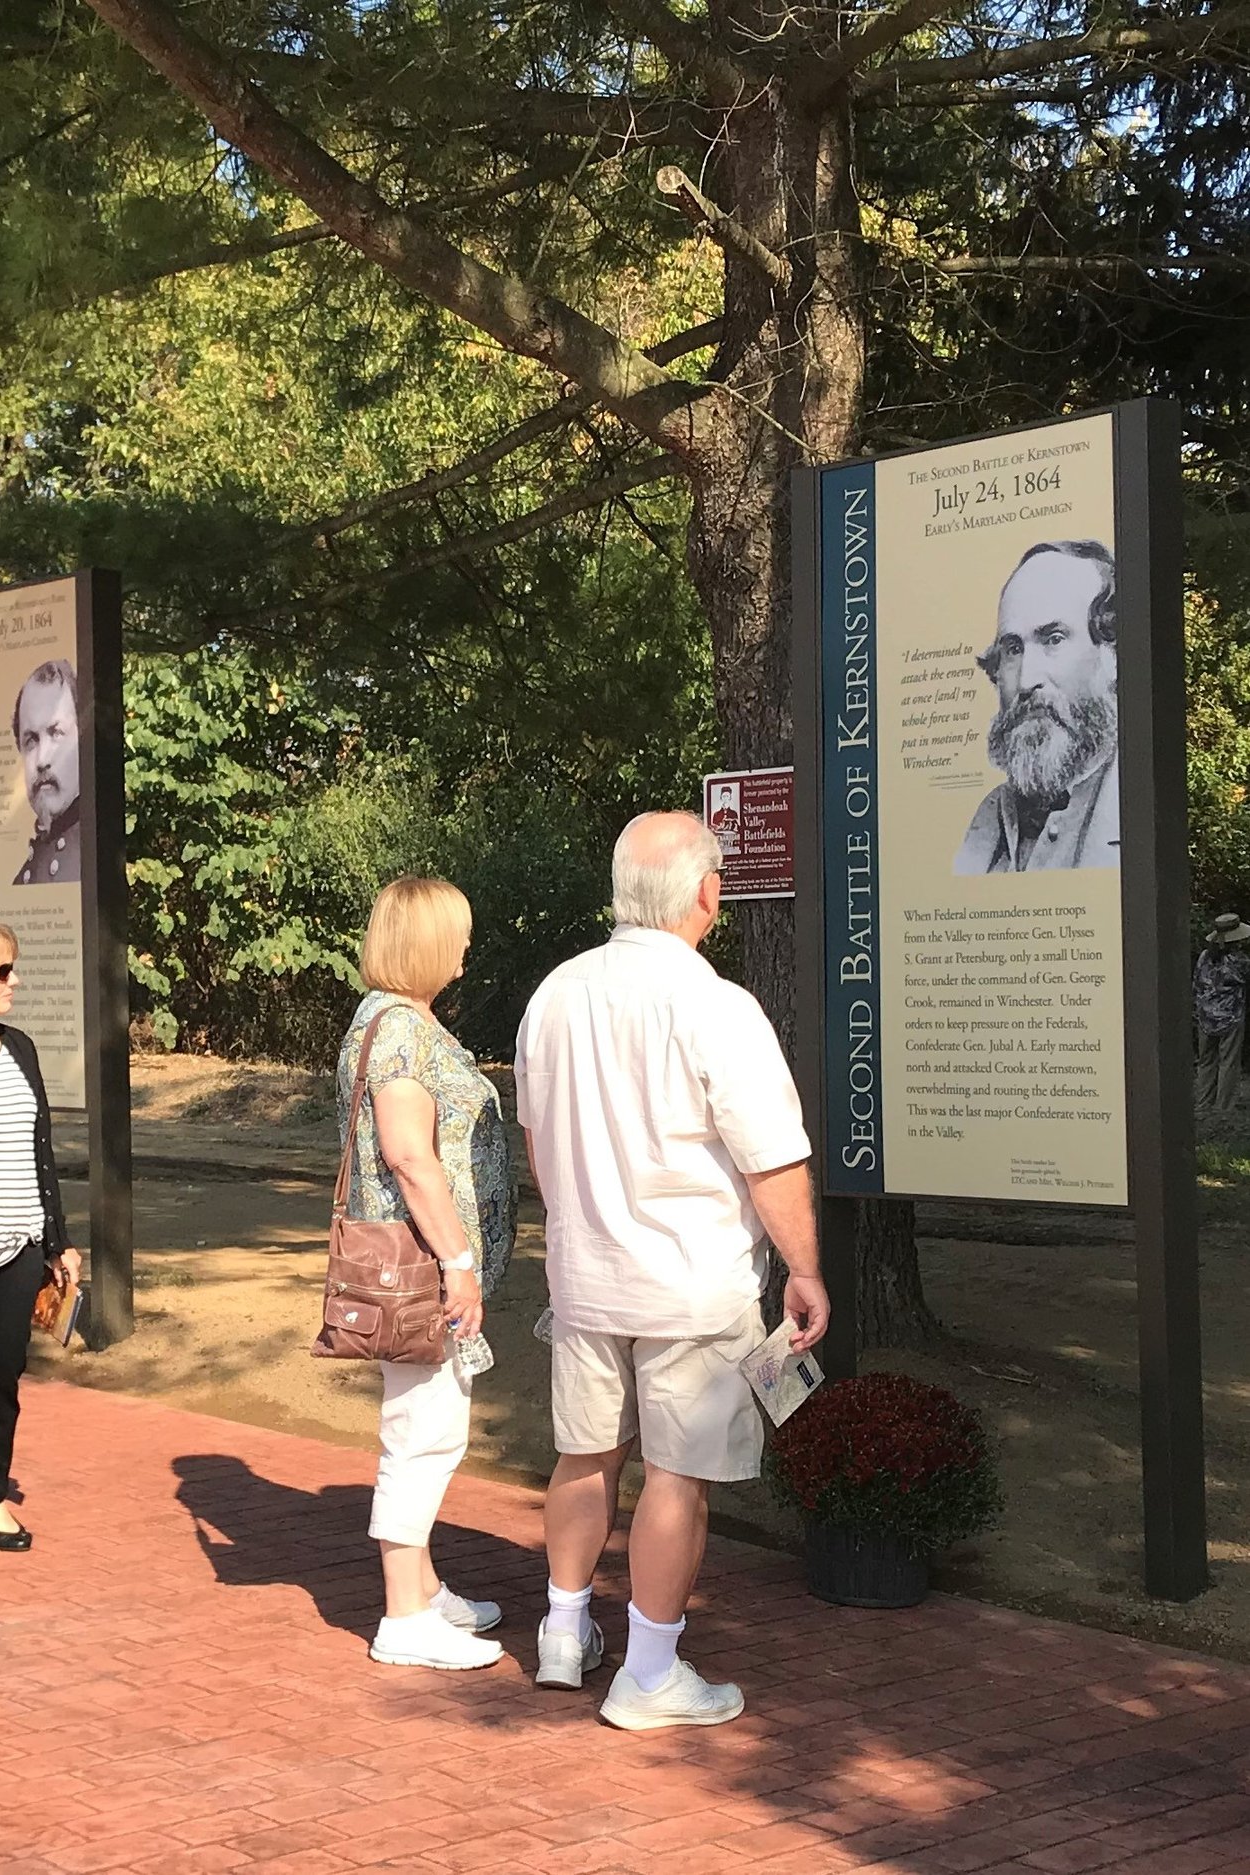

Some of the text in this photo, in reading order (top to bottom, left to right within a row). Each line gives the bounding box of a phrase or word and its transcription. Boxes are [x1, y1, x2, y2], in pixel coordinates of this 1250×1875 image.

[908, 441, 1091, 485] THE SECOND BATTLE OF KERNSTOWN
[932, 465, 1061, 517] July 24, 1864
[925, 502, 1072, 537] EARLY'S MARYLAND CAMPAIGN
[30, 611, 52, 630] 1864
[911, 643, 963, 662] determined
[964, 645, 973, 655] to
[901, 668, 975, 685] attack the enemy
[901, 687, 977, 706] at once [and] my
[902, 711, 970, 729] whole force was
[901, 729, 979, 752] put in motion for
[903, 753, 959, 769] Winchester."
[743, 800, 788, 814] Shenandoah
[744, 816, 766, 829] Valley
[837, 488, 875, 1172] SECOND BATTLE OF KERNSTOWN
[744, 827, 786, 841] Battlefields
[744, 842, 786, 854] Foundation
[904, 905, 1086, 921] When Federal commanders sent troops
[904, 926, 1095, 945] from the Valley to reinforce Gen. Ulysses
[904, 948, 1102, 966] S. Grant at Petersburg, only a small Union
[905, 971, 1106, 987] force, under the command of Gen. George
[905, 993, 1092, 1008] Crook, remained in Winchester. Under
[905, 1016, 1088, 1033] orders to keep pressure on the Federals,
[905, 1038, 1101, 1055] Confederate Gen. Jubal A. Early marched
[906, 1060, 1097, 1075] north and attacked Crook at Kernstown,
[906, 1082, 1099, 1100] overwhelming and routing the defenders.
[907, 1104, 1111, 1124] This was the last major Confederate victory
[907, 1125, 965, 1142] in the Valley.
